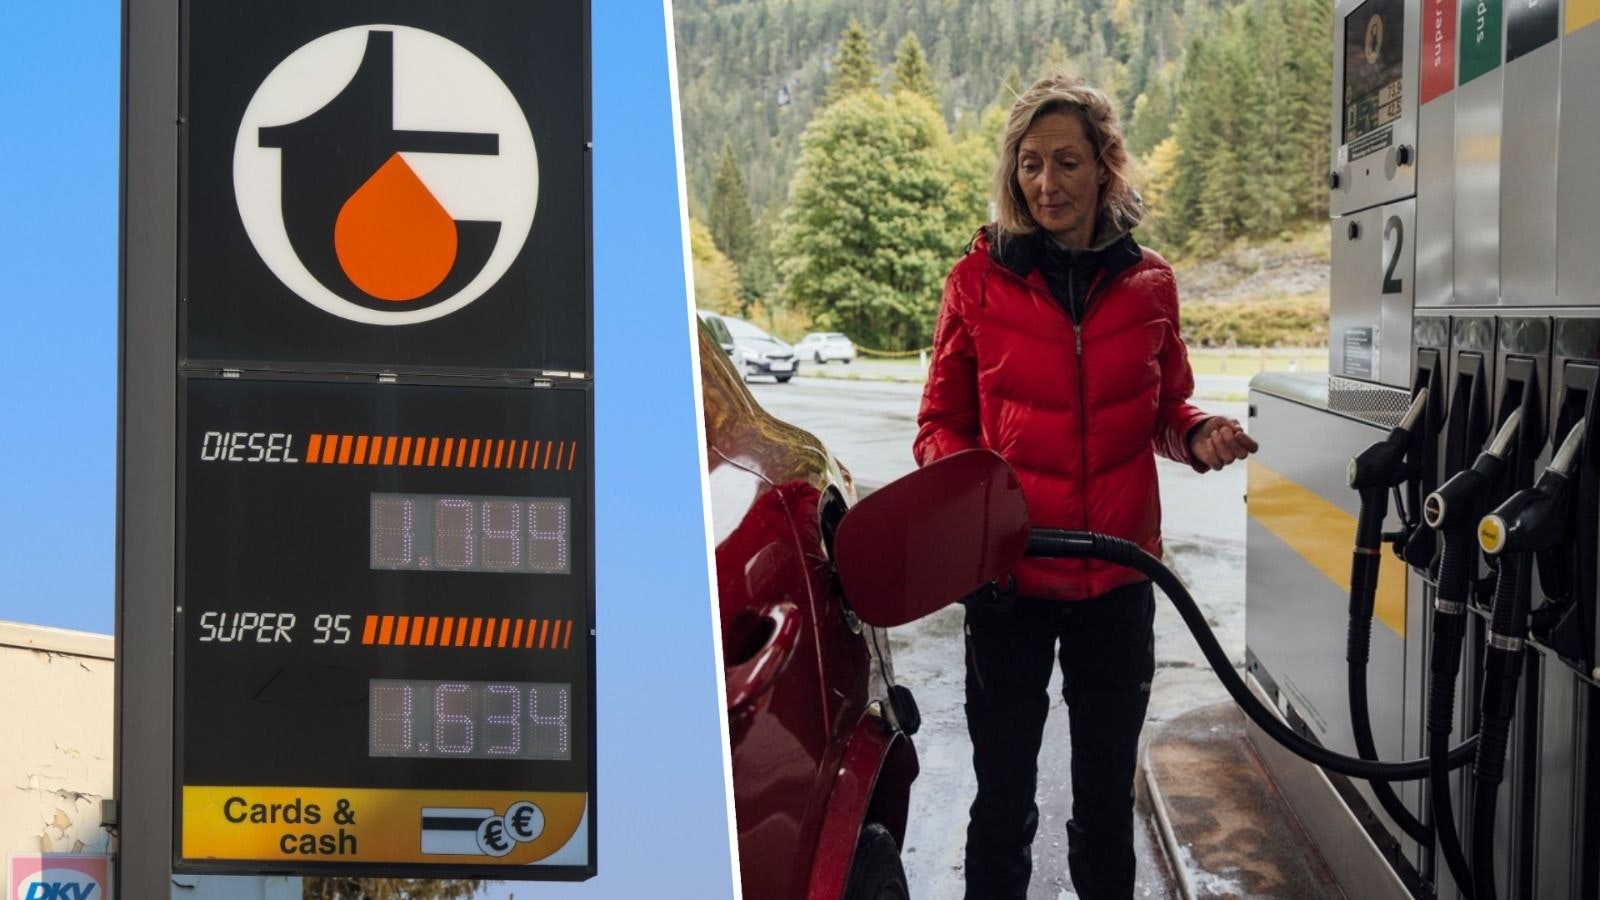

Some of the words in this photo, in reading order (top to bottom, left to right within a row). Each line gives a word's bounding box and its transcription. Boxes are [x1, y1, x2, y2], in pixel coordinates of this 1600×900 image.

[1434, 9, 1444, 67] super
[1476, 0, 1487, 44] sup
[1382, 215, 1403, 294] 2
[200, 431, 298, 463] DIESEL
[402, 498, 566, 569] 1.744
[199, 611, 296, 643] SUPER
[313, 614, 351, 644] 95
[403, 683, 567, 753] 1.634
[224, 797, 321, 825] Cards
[333, 799, 356, 825] &
[279, 828, 357, 855] cash
[25, 882, 96, 900] DKV
